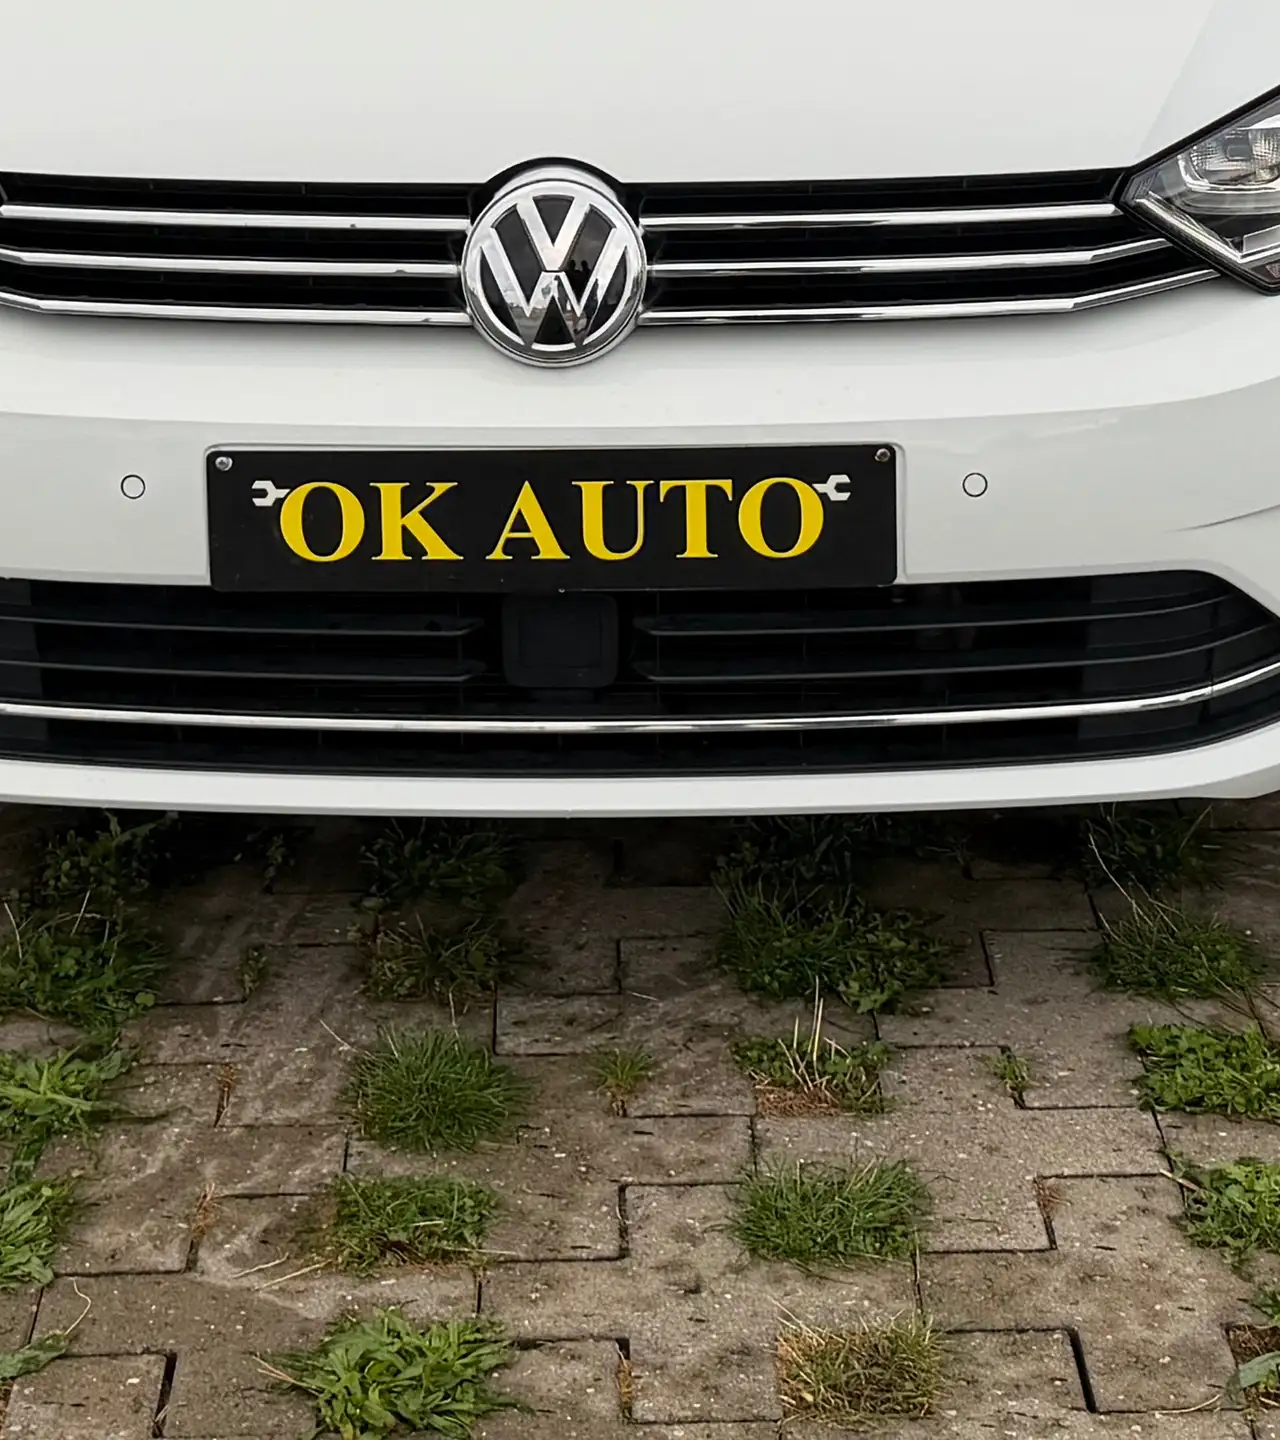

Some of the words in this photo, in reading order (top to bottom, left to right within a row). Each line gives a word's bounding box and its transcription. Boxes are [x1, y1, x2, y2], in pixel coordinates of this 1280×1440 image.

[470, 186, 637, 359] VW
[279, 480, 464, 563] OK
[485, 477, 824, 561] AUTO
